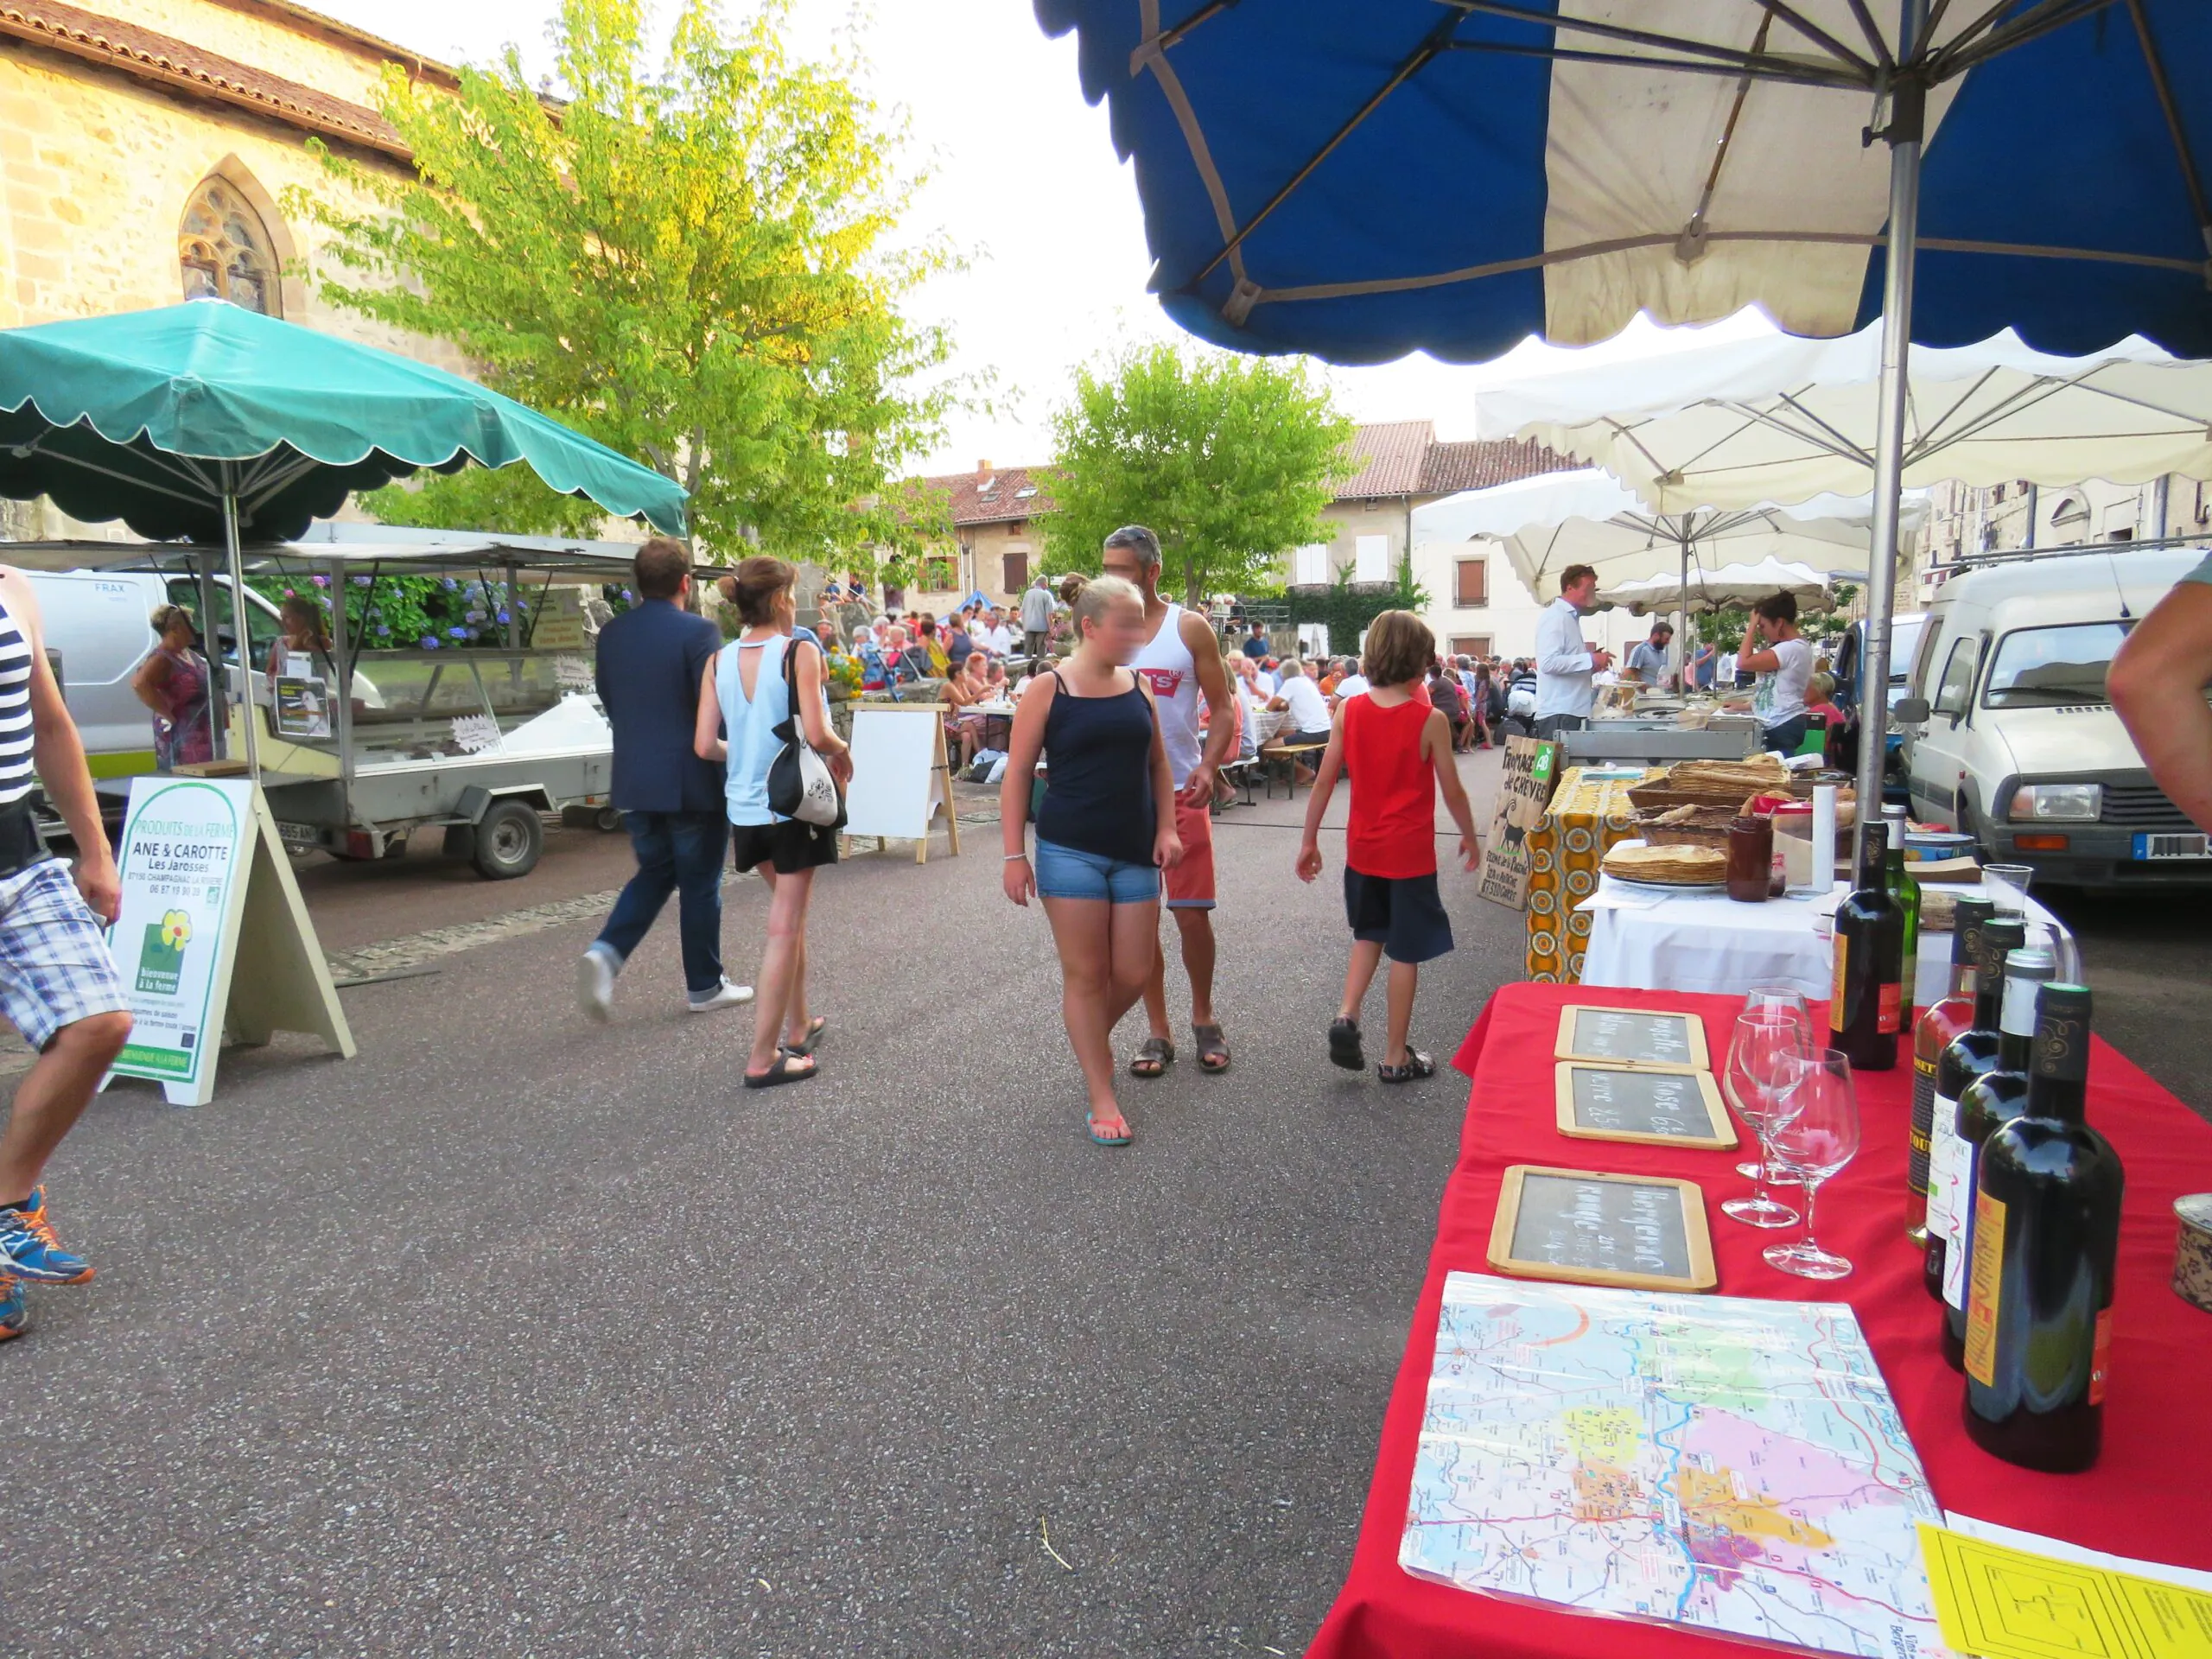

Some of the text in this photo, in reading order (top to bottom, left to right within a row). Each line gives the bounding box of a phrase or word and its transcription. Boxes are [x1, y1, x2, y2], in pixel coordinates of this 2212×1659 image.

[137, 820, 183, 836] PRODUITS
[207, 823, 234, 839] FERME
[132, 842, 228, 861] ANE & CAROTTE
[148, 858, 209, 872] Les Jarosses
[147, 873, 190, 884] CHAMPAGNAC
[149, 884, 159, 893] 06
[141, 967, 179, 980] bienvenue
[145, 981, 154, 989] la
[155, 980, 176, 991] ferme
[1904, 1635, 1917, 1653] Vins
